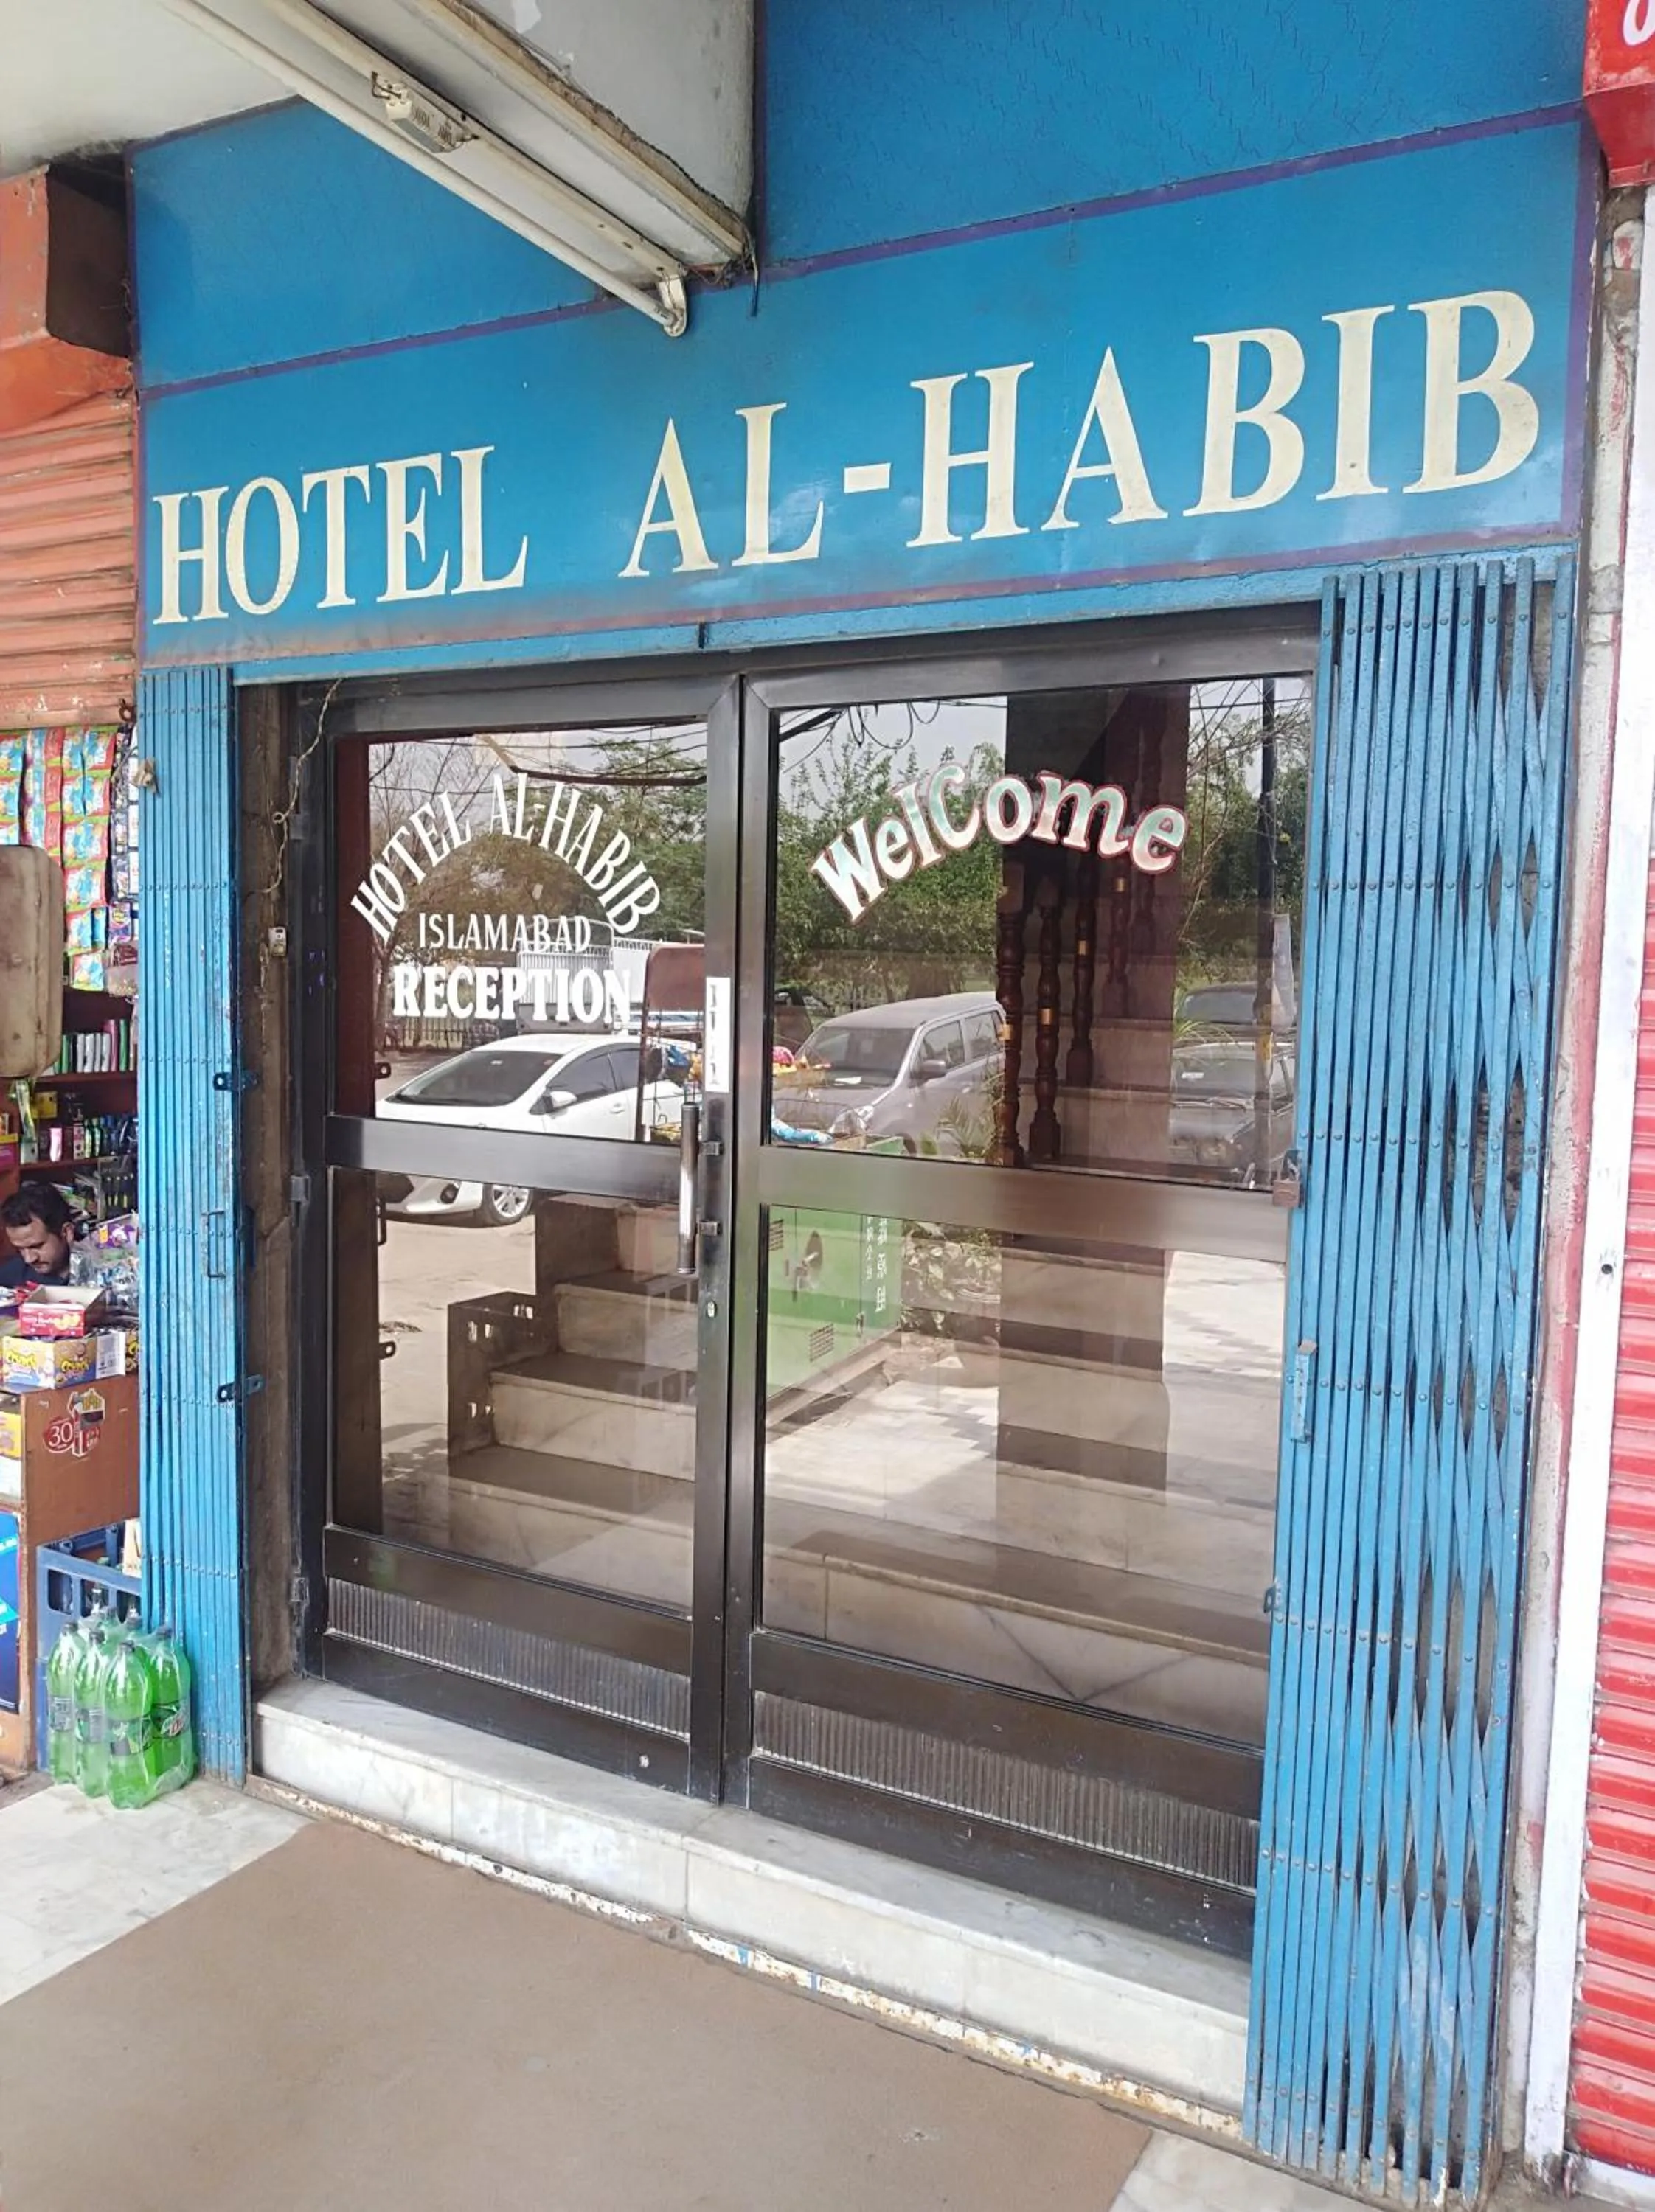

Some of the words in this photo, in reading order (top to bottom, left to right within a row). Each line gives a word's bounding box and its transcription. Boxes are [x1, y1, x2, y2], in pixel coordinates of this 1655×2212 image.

[153, 445, 528, 625] HOTEL
[350, 790, 472, 947] HOTEL
[419, 912, 591, 954] ISLAMABAD
[392, 965, 631, 1025] RECEPTION
